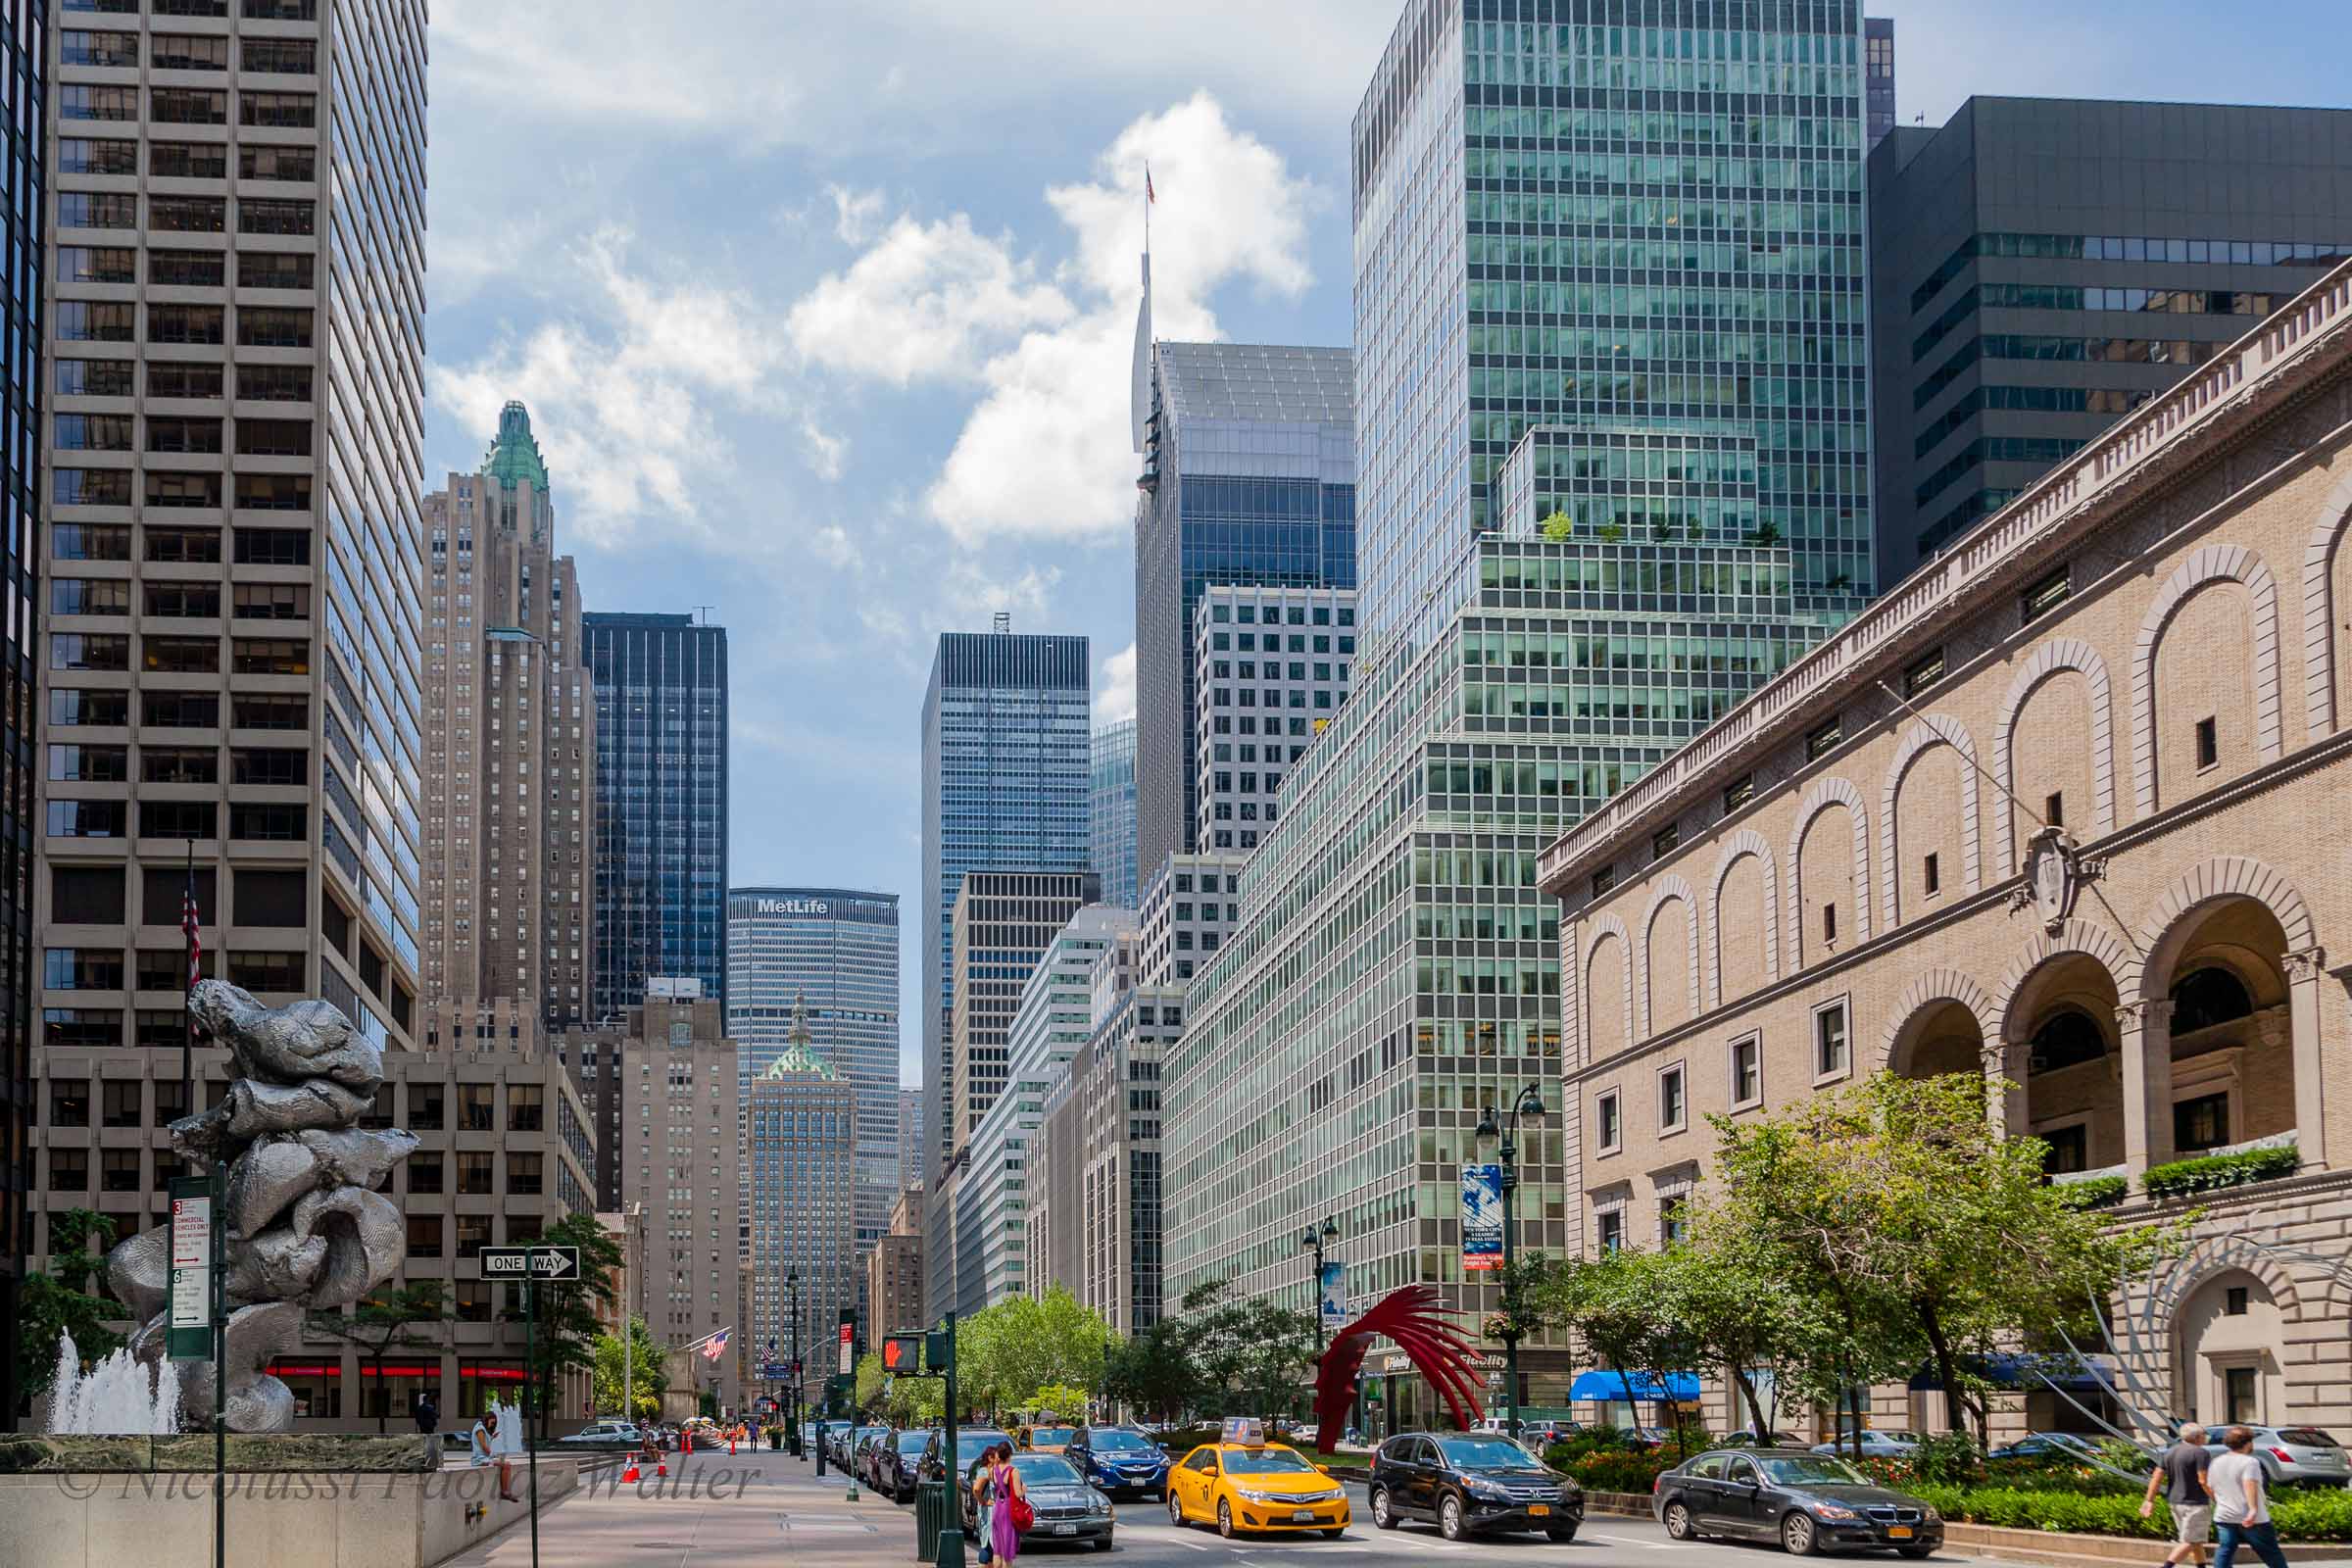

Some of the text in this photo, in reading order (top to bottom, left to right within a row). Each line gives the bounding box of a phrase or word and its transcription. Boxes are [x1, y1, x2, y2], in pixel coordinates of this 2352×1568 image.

[758, 899, 828, 913] MetLife
[174, 1201, 181, 1214] 3
[494, 1257, 563, 1269] ONE WAY
[173, 1269, 180, 1283] 6
[1459, 1354, 1508, 1368] Fidelity
